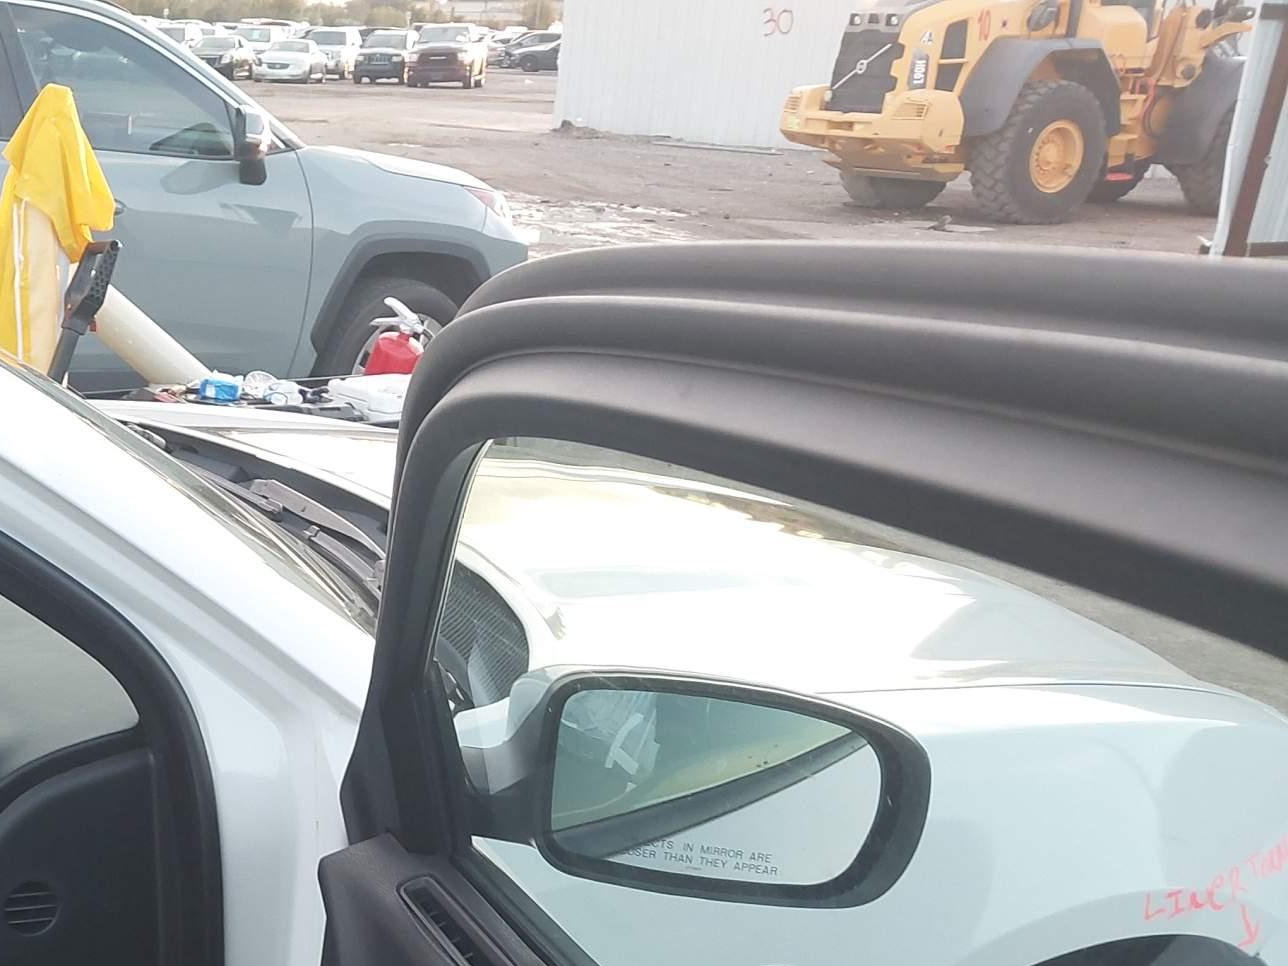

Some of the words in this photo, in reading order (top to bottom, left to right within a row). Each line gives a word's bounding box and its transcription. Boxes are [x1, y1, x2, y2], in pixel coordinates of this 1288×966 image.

[762, 7, 794, 37] 30
[663, 851, 693, 864] THAN
[700, 856, 728, 869] THEY
[733, 861, 778, 876] APPEAR
[683, 842, 694, 852] IN
[700, 844, 744, 860] MIRROR
[748, 851, 773, 863] ARE
